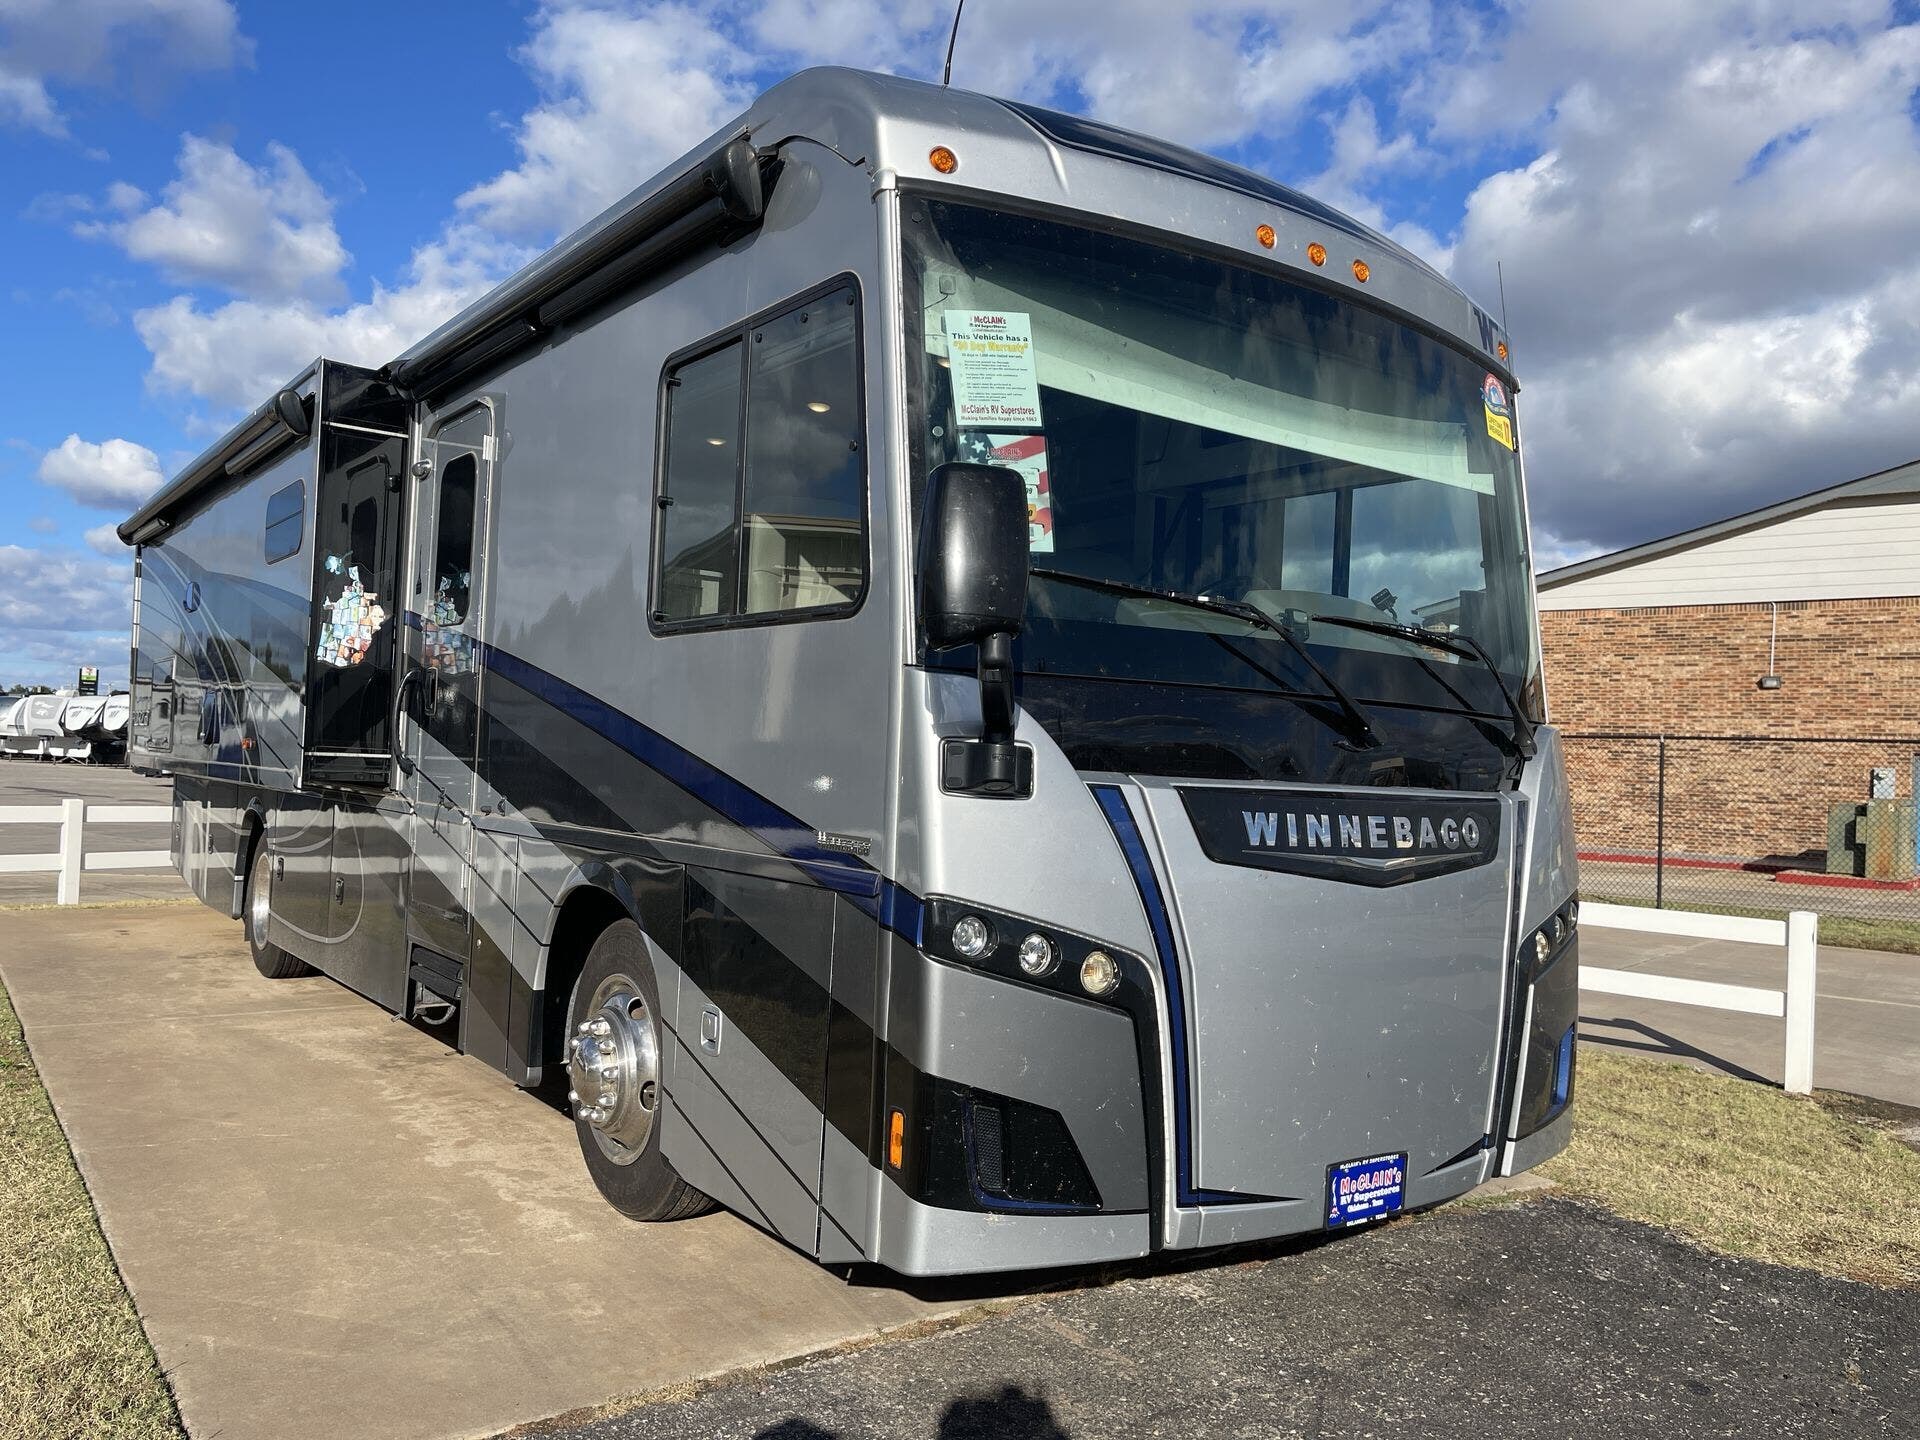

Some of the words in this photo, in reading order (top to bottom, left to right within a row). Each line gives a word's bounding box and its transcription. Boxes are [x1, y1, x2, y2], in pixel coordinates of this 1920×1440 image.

[973, 333, 1004, 341] Vehicle
[961, 404, 990, 414] McClain's
[991, 405, 999, 414] RV
[1000, 405, 1035, 416] Superstores
[1242, 810, 1481, 851] WINNEBAGO
[1340, 1167, 1401, 1195] McCLAIN's
[1340, 1194, 1352, 1205] RV
[1353, 1185, 1400, 1202] Superstores
